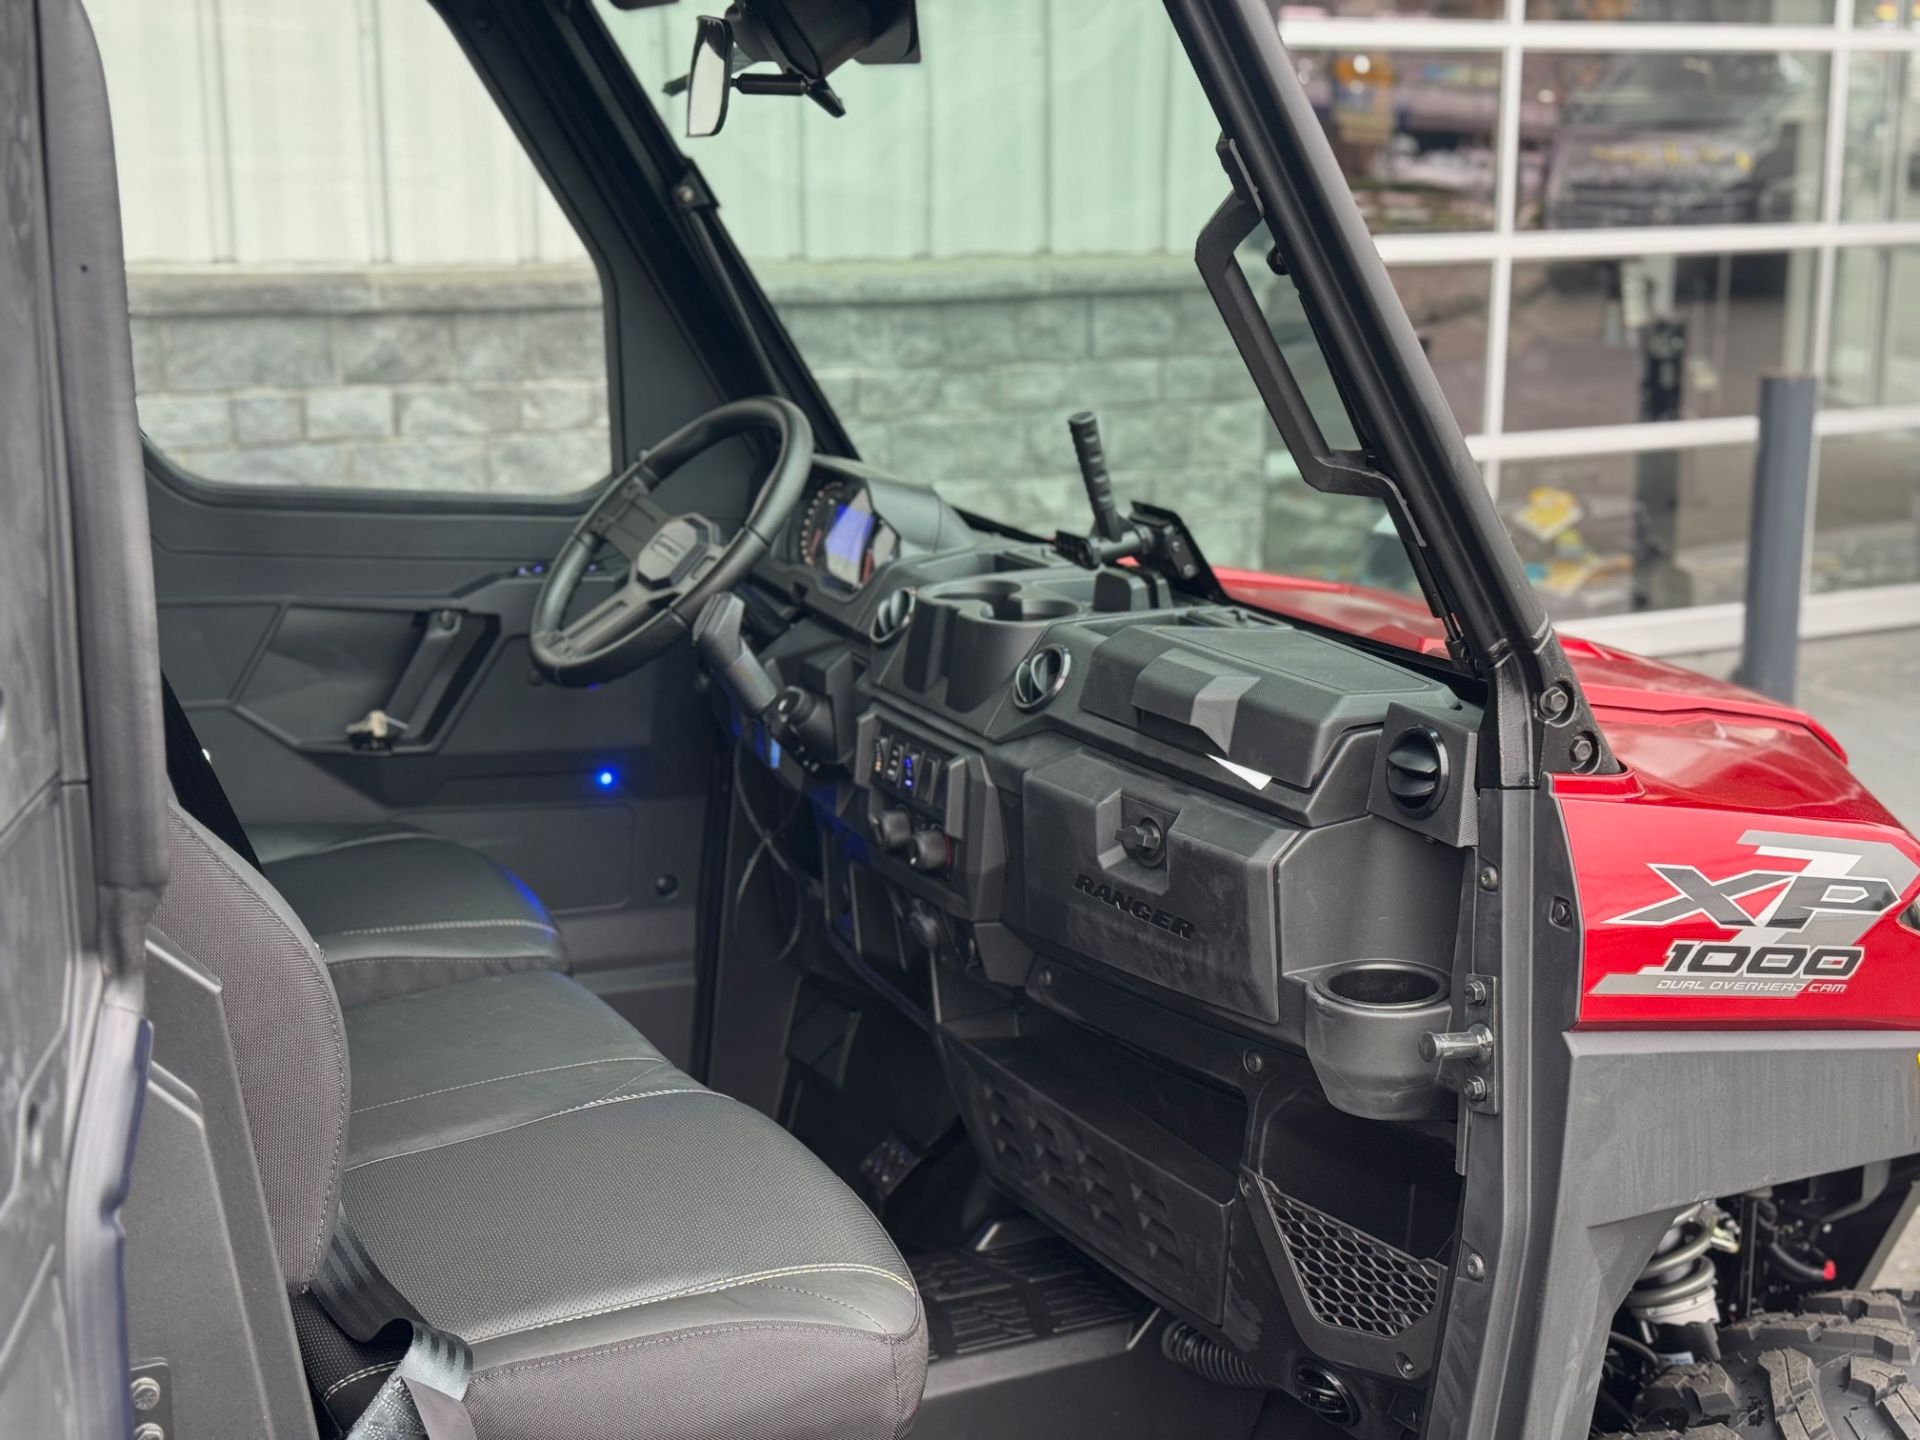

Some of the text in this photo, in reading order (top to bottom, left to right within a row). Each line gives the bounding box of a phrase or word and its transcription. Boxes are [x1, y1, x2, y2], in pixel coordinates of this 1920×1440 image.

[1073, 873, 1195, 941] RANGER
[1601, 863, 1901, 932] XP
[1662, 940, 1864, 979] 1000
[1656, 979, 1849, 994] DUAL OVERHEAD CAM
